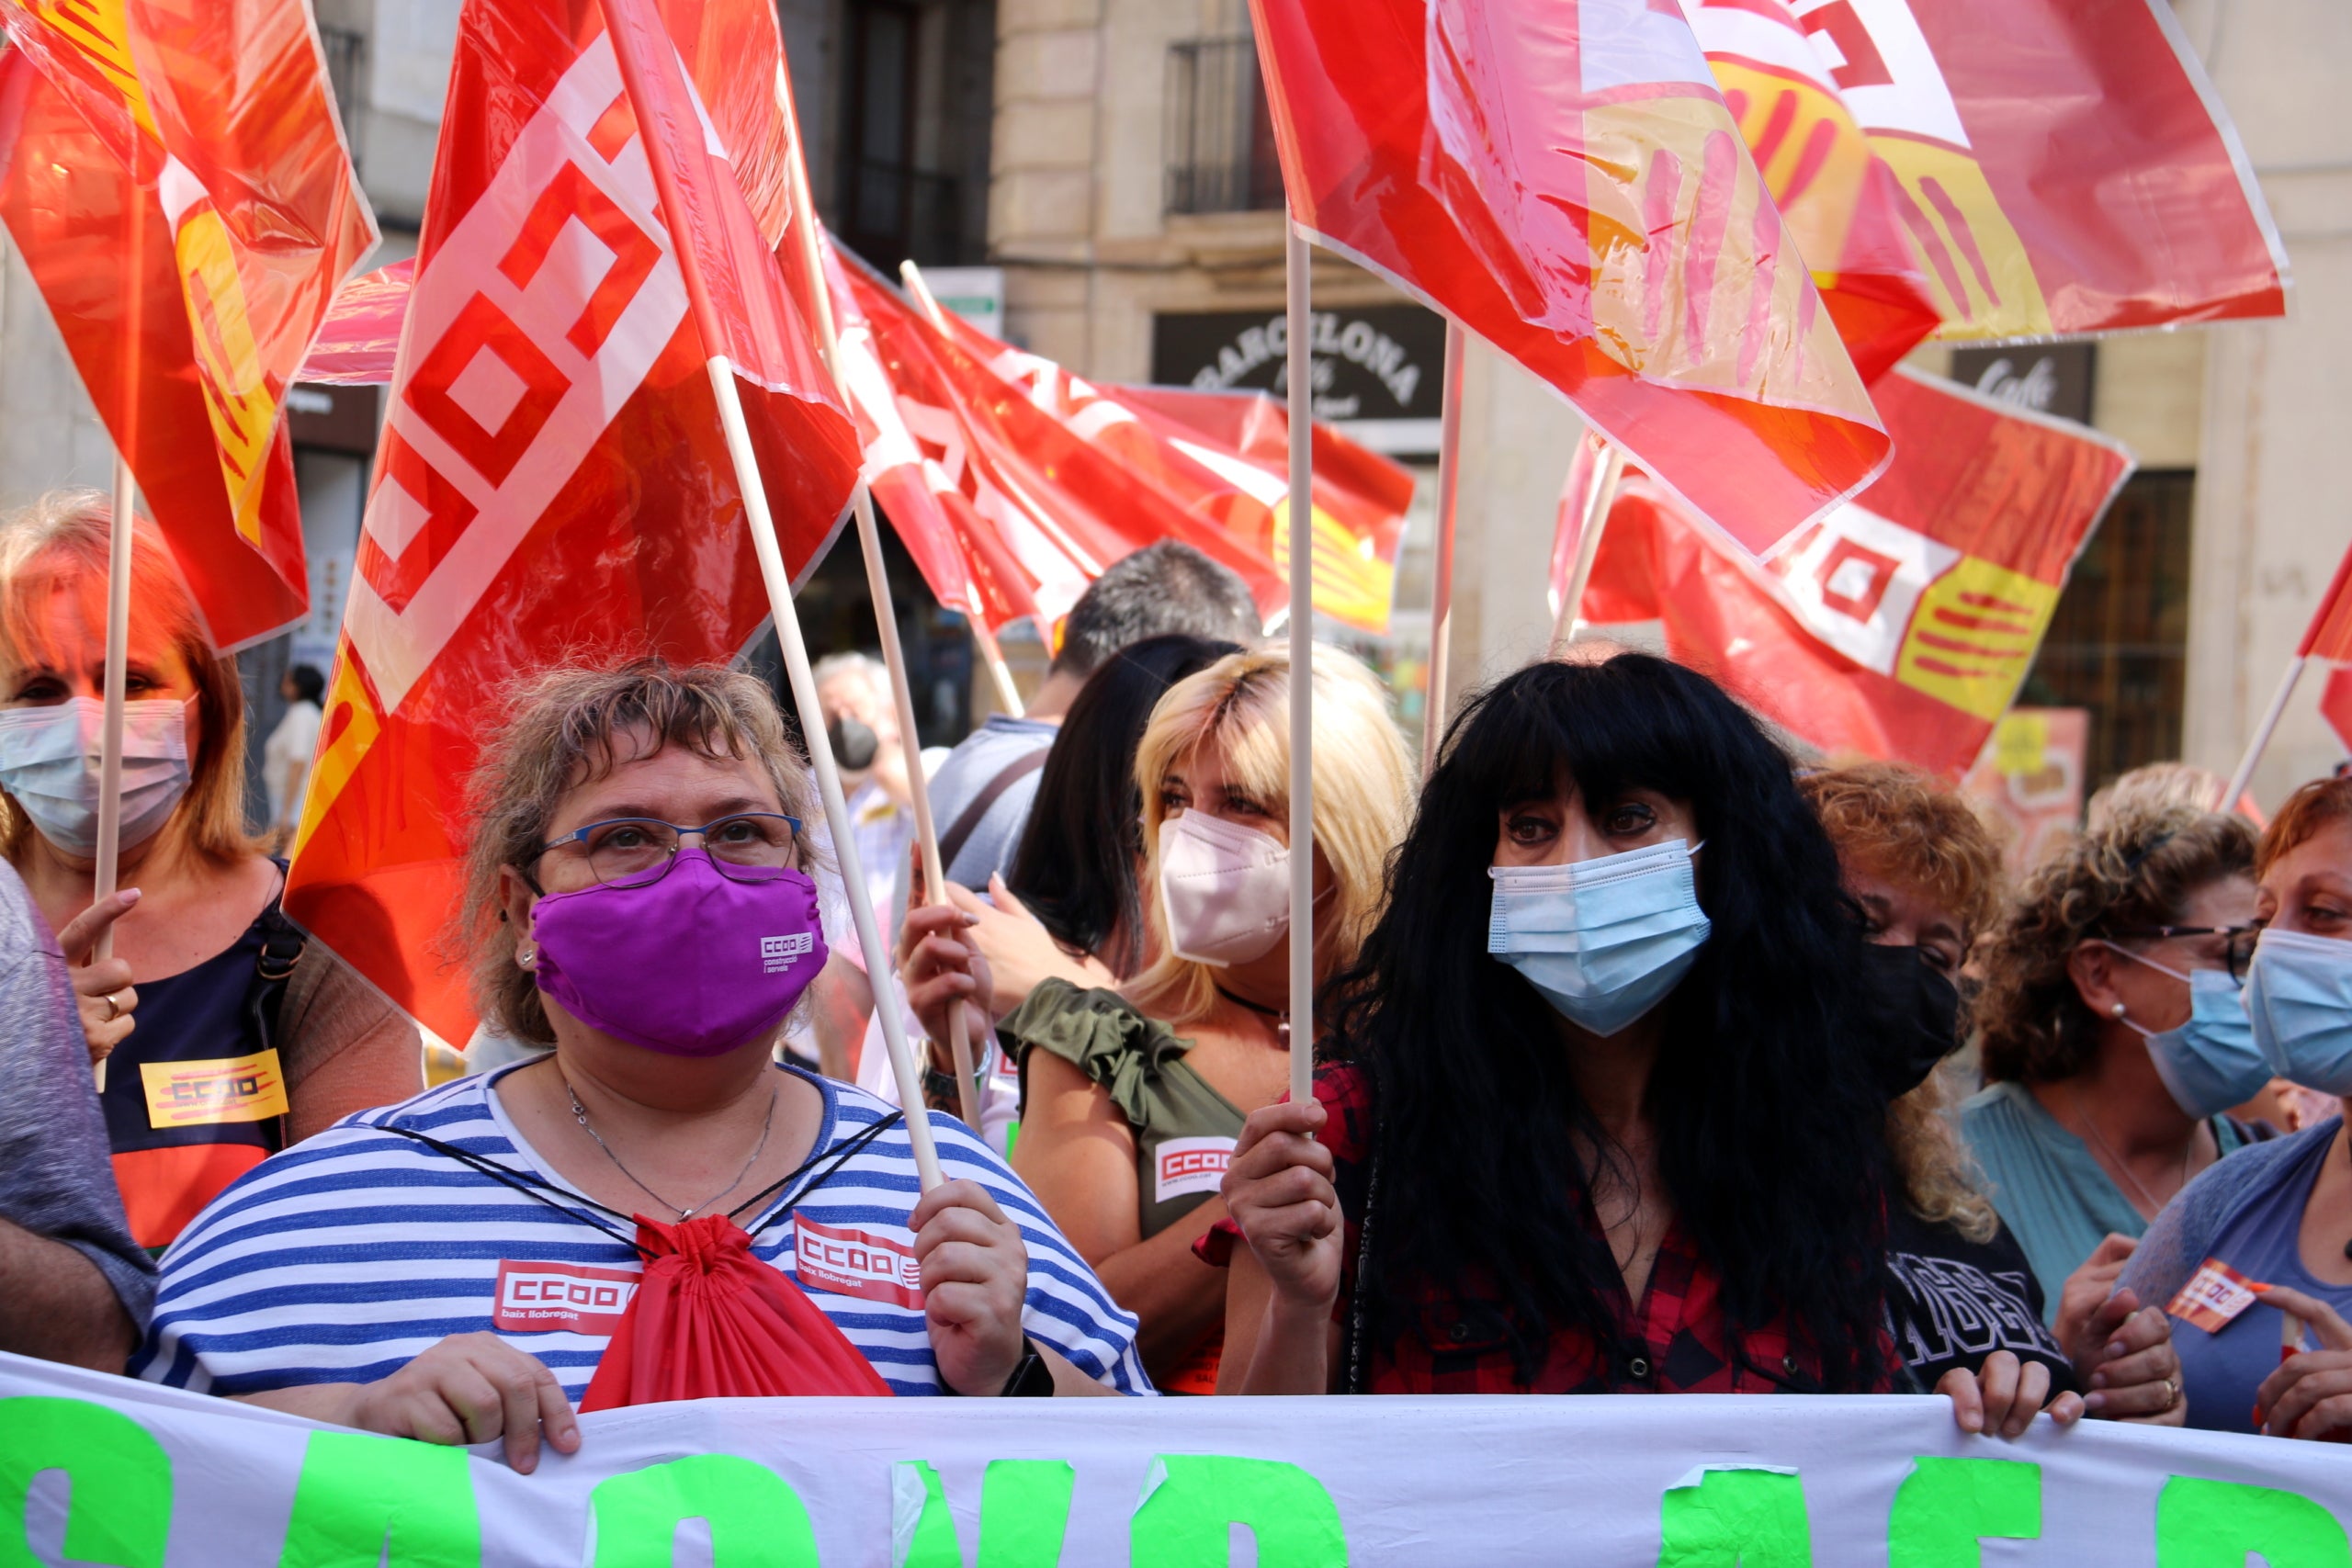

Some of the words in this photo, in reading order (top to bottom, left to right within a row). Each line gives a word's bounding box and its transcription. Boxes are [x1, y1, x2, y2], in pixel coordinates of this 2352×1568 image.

[764, 939, 797, 953] CCOO
[763, 955, 797, 965] construcció
[171, 1077, 258, 1100] CCOO
[803, 1235, 893, 1275] CCOO
[797, 1260, 817, 1276] baix
[818, 1270, 863, 1288] llobregat
[513, 1280, 618, 1307] CCOO
[501, 1309, 526, 1318] baix
[528, 1309, 580, 1321] llobregat
